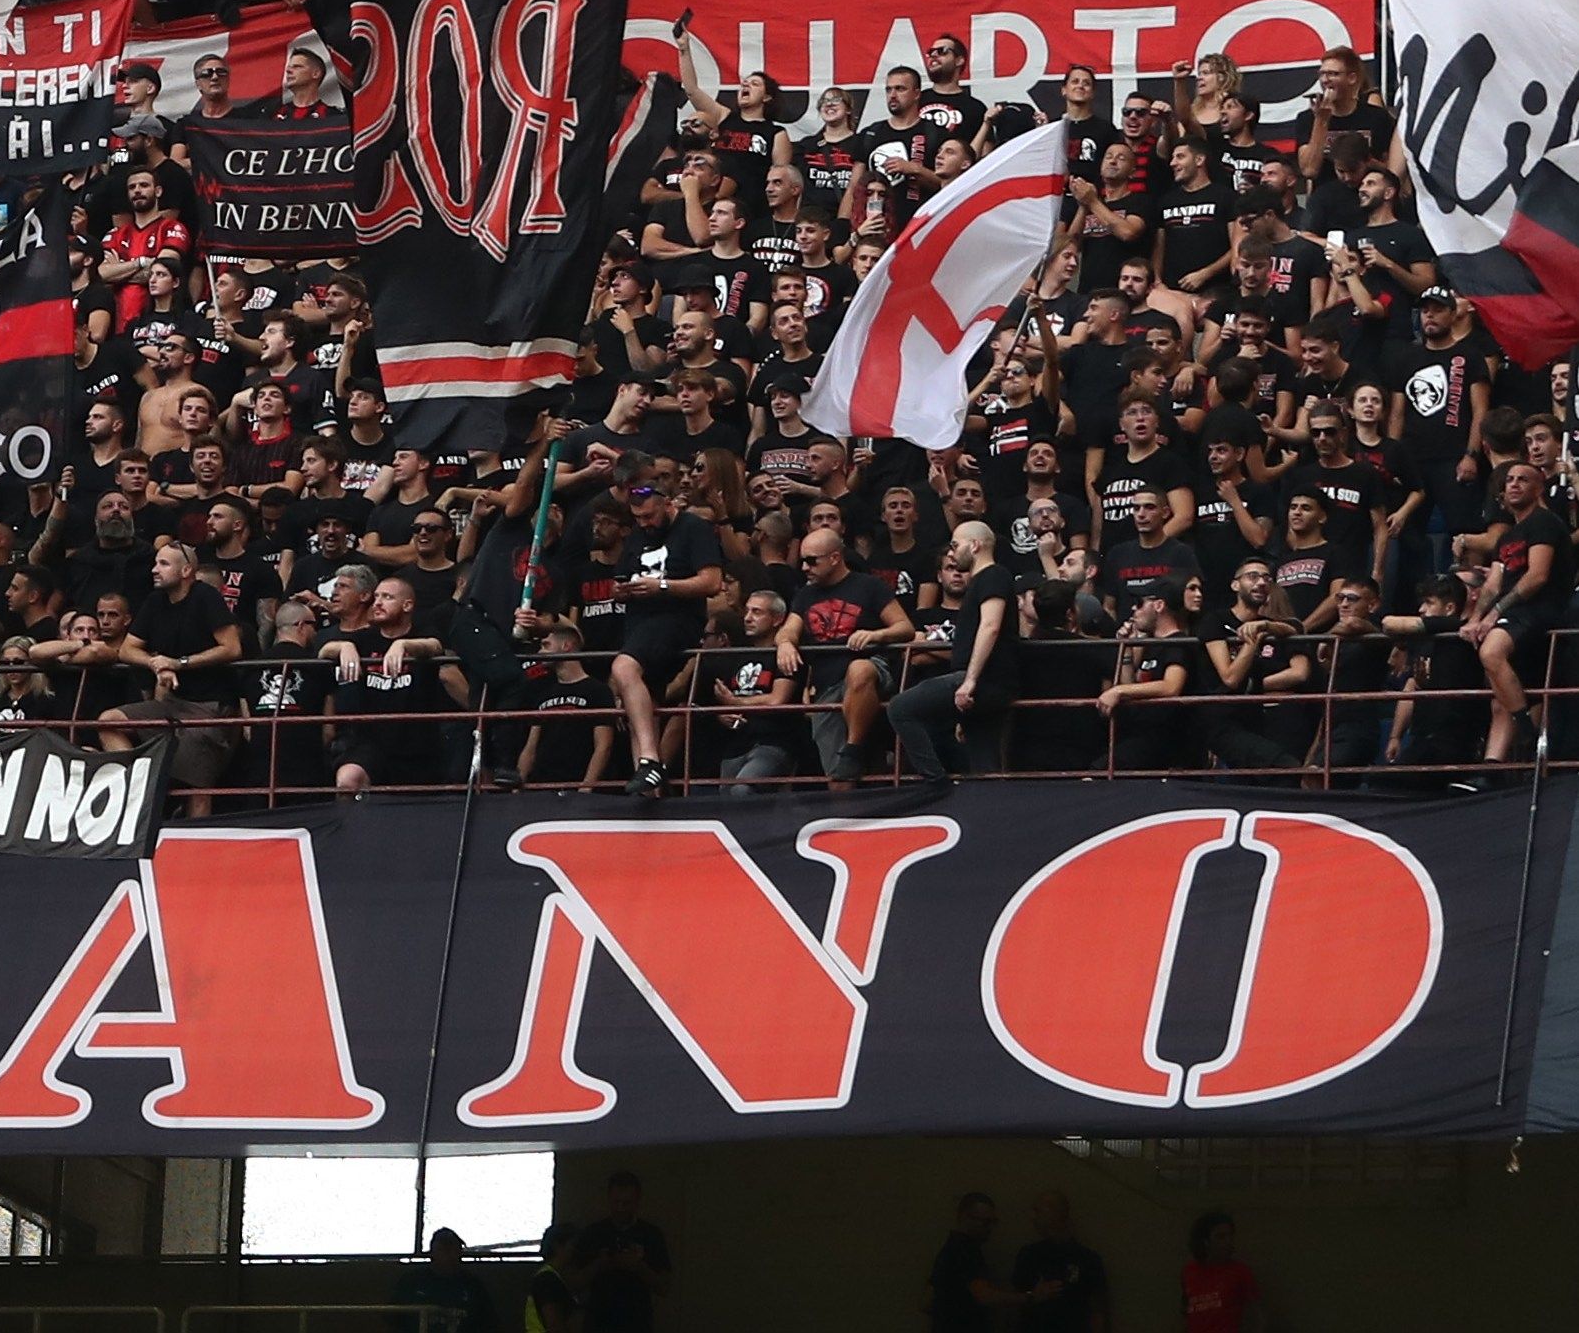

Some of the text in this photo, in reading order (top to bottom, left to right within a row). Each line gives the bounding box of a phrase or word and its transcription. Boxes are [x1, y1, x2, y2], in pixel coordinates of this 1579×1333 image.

[53, 8, 100, 47] TI
[223, 147, 266, 179] CE
[213, 203, 251, 231] IN
[1162, 202, 1216, 220] BANDITI
[1337, 488, 1360, 504] SUD
[582, 601, 613, 618] URVA
[24, 753, 153, 846] NOI
